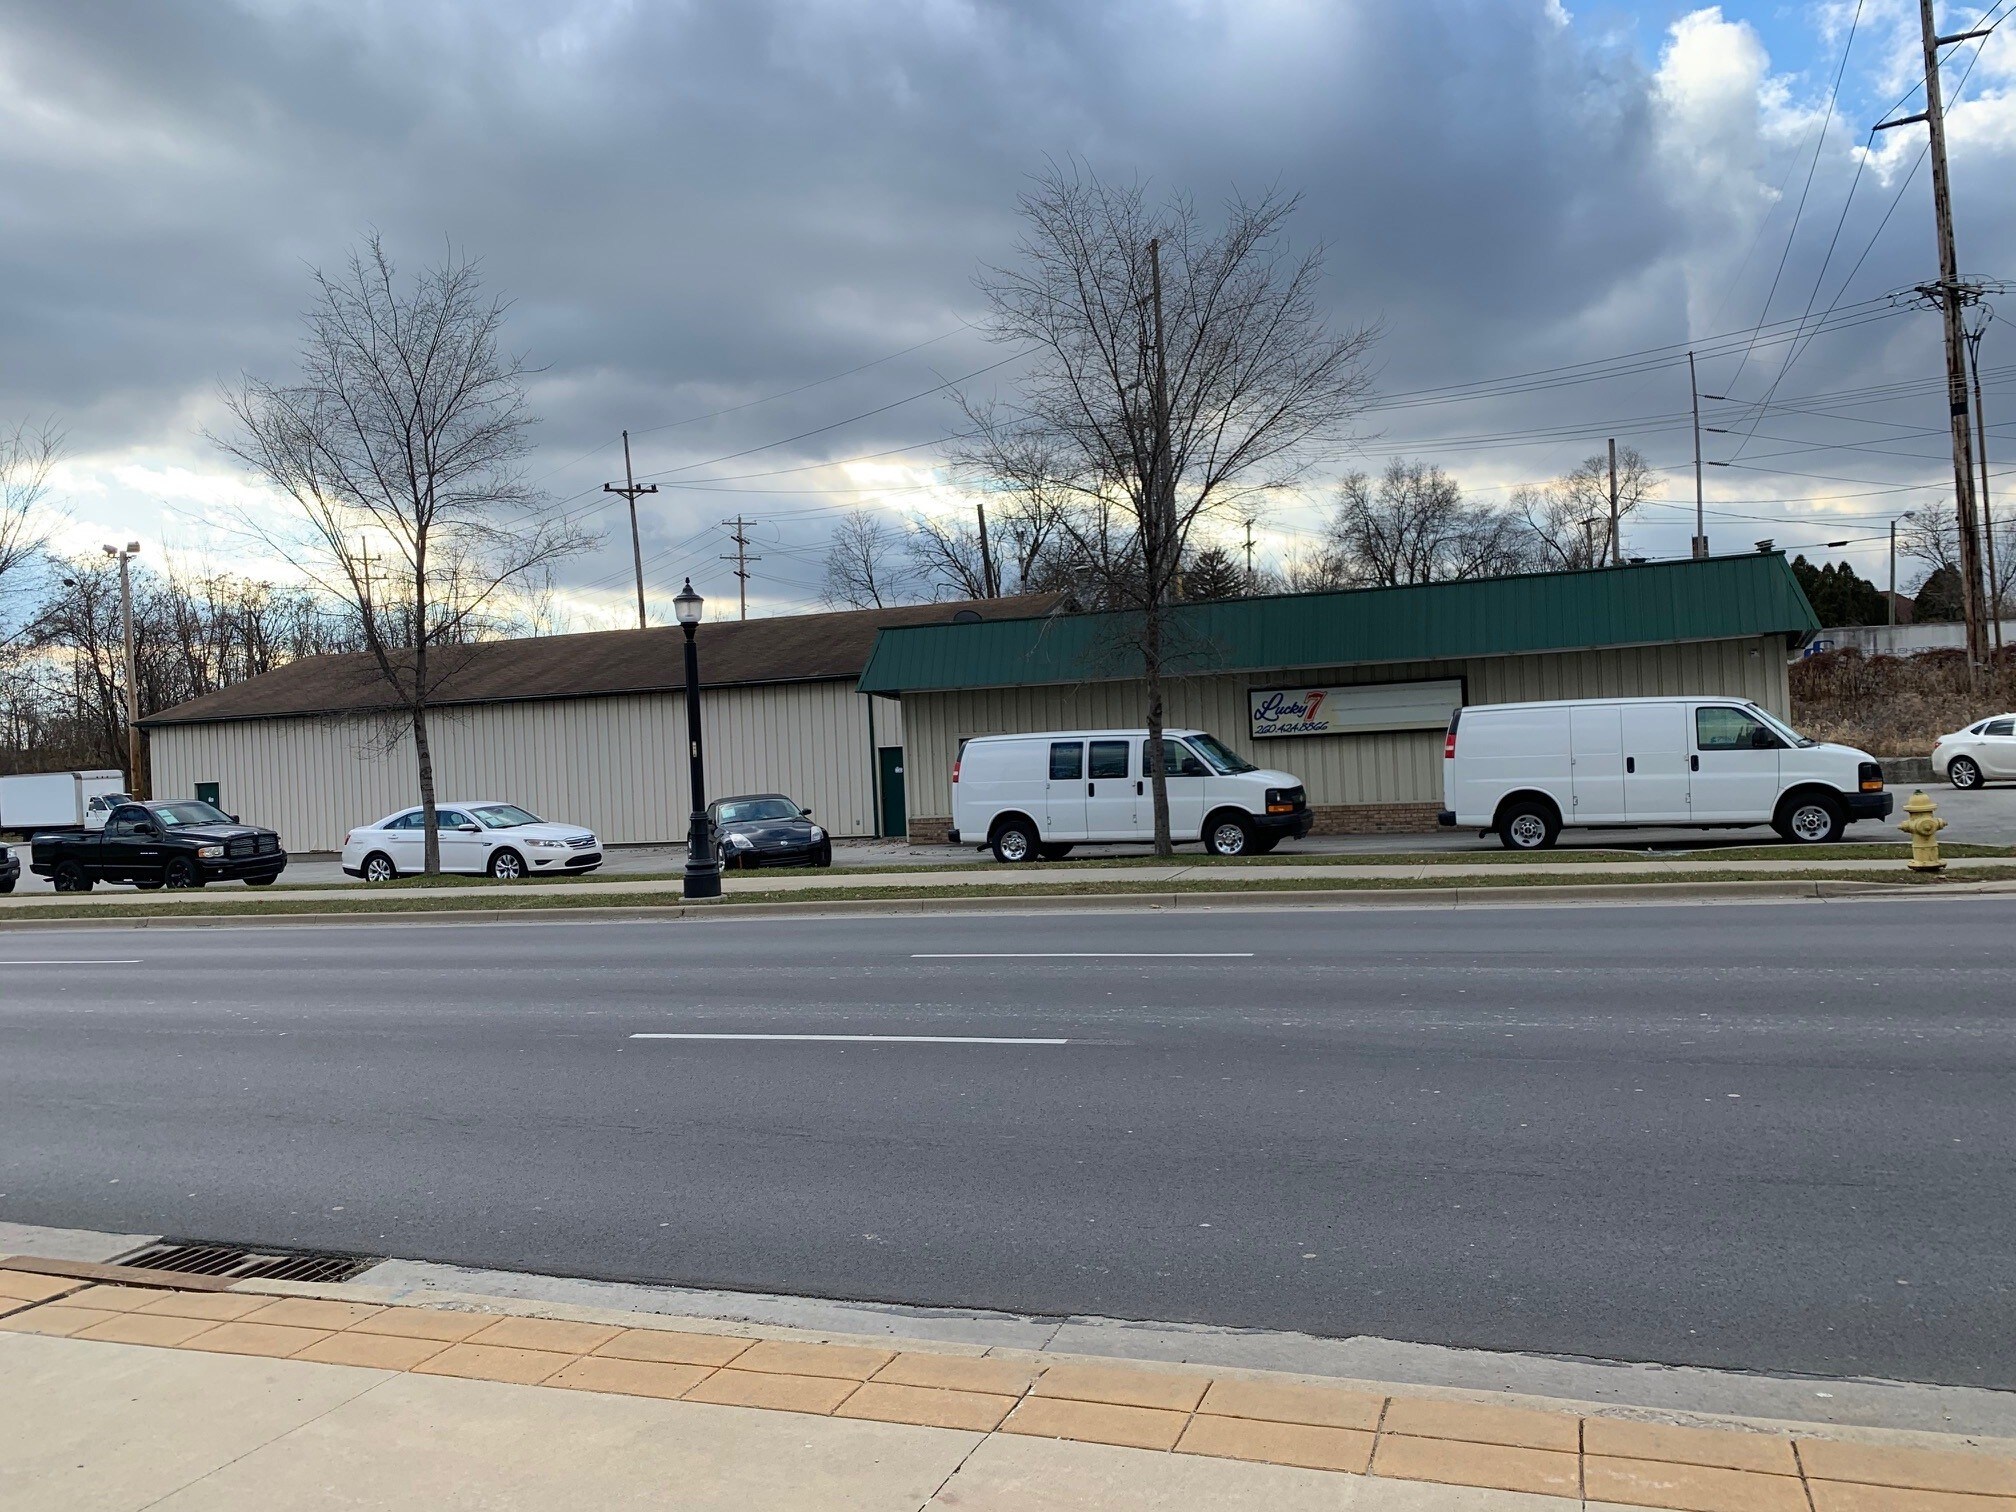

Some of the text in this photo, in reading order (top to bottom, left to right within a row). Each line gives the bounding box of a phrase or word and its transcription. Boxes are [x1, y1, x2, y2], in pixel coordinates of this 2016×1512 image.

[1254, 690, 1327, 722] Lucky 7
[1255, 721, 1329, 734] 260.424.8866
